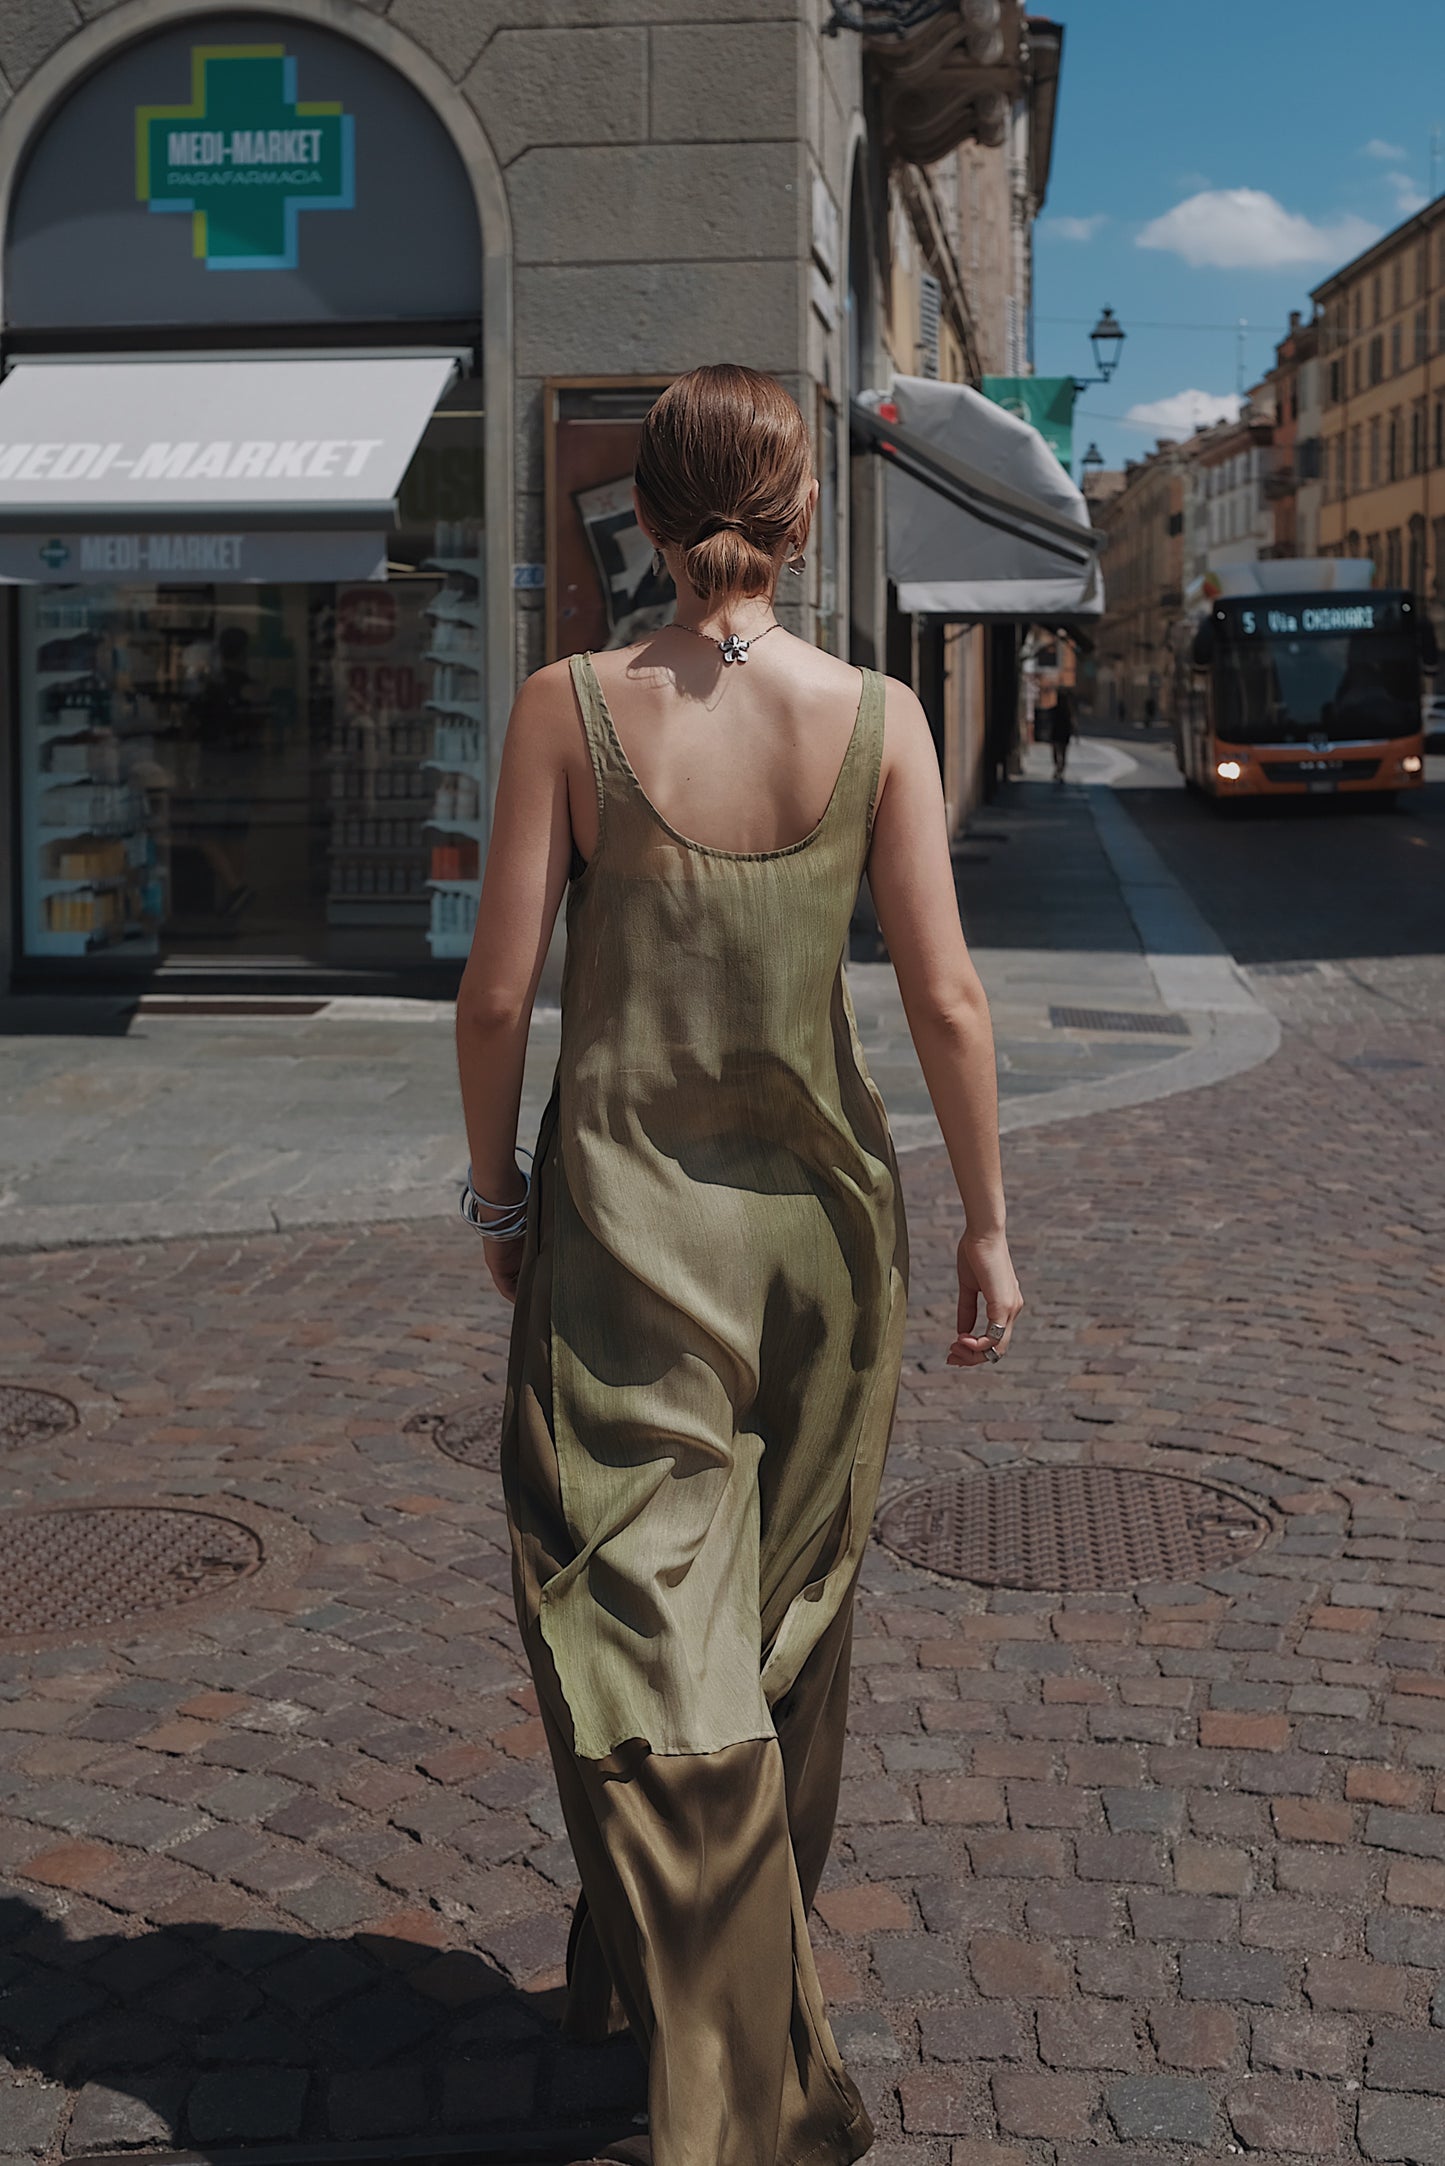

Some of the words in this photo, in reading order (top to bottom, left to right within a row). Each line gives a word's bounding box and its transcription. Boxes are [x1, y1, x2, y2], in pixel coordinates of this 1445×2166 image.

[168, 129, 322, 166] MEDI-MARKET
[167, 170, 323, 187] PARAFARMACIA
[80, 535, 243, 570] MEDI-MARKET
[1267, 609, 1298, 632] Via
